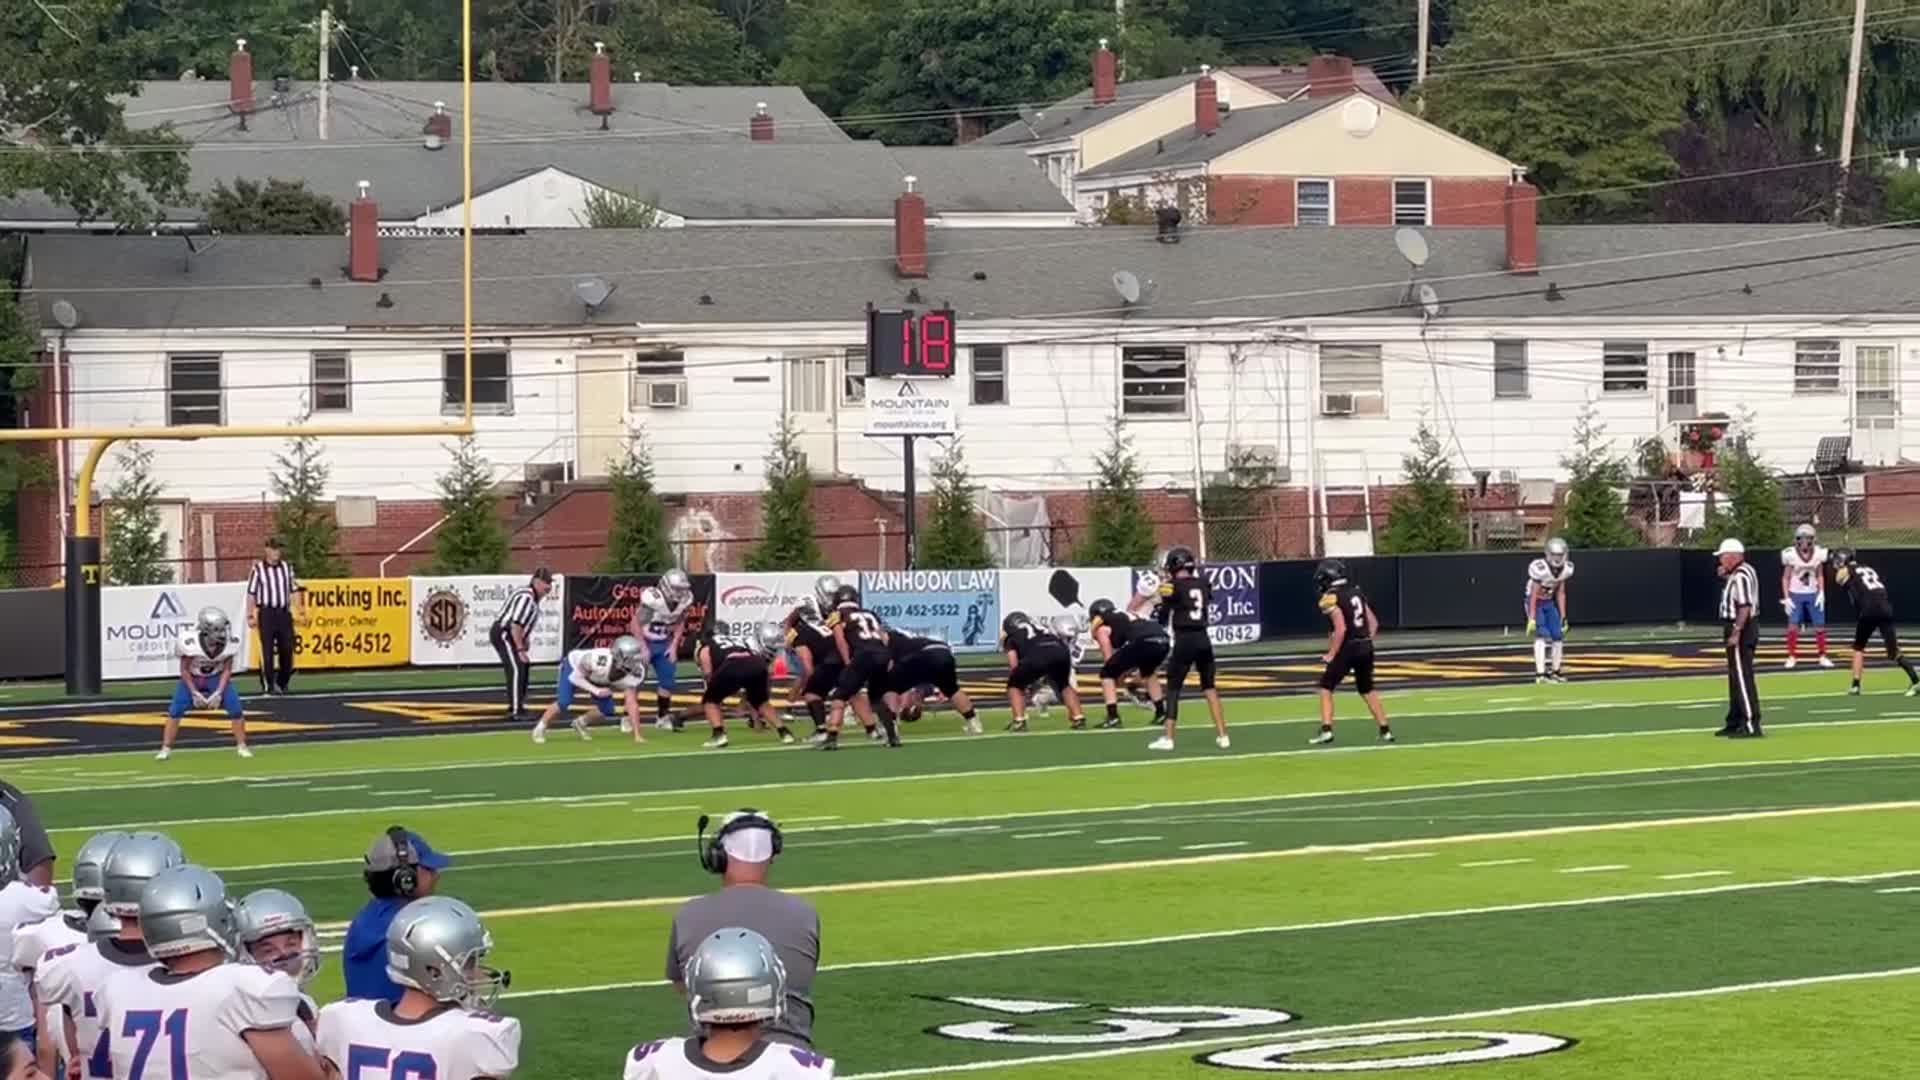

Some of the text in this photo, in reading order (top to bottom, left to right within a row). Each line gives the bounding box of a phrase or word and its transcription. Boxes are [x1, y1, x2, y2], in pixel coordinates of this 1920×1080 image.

[903, 313, 951, 369] 18
[871, 399, 950, 409] MOUNTAIN
[80, 564, 99, 585] T
[866, 569, 996, 592] VANHOOK LAW
[298, 585, 407, 611] Trucking Inc.
[1189, 588, 1204, 620] 3
[1227, 596, 1255, 616] Inc.
[905, 603, 960, 617] 452-5522
[1350, 595, 1364, 627] 2
[293, 632, 392, 655] 8-246-4512
[121, 1007, 189, 1080] 71
